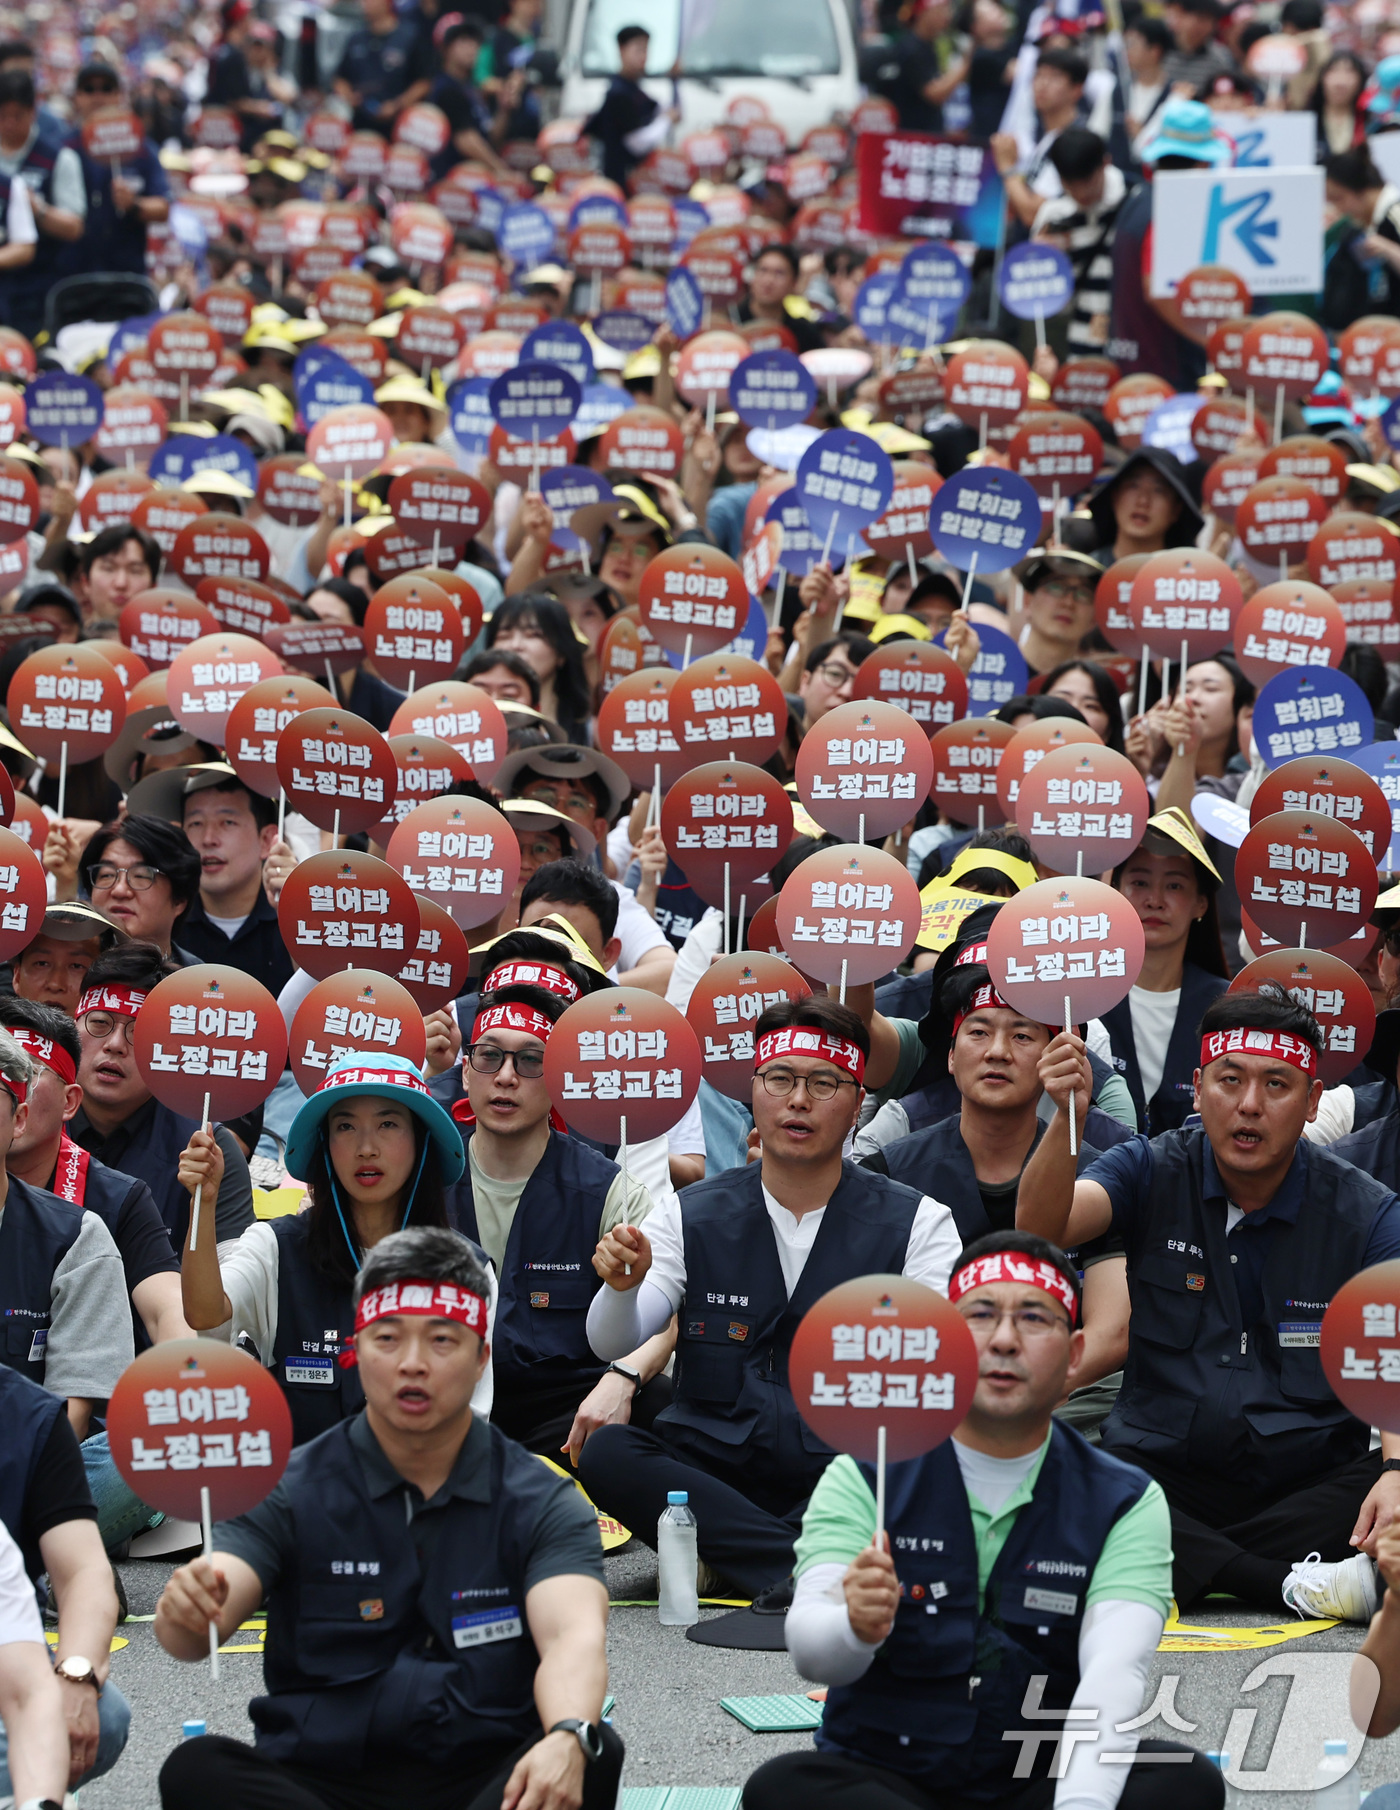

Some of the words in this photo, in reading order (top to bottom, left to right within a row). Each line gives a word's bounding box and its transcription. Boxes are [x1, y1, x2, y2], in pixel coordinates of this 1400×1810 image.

[1259, 334, 1314, 357] 열어라
[746, 370, 800, 390] 멈춰라
[962, 361, 1016, 386] 열어라
[1246, 357, 1320, 382] 노정교섭
[507, 379, 564, 398] 멈춰라
[737, 391, 807, 411] 일방통행
[952, 385, 1022, 410] 노정교섭
[499, 397, 573, 418] 일방통행
[325, 421, 378, 444] 열어라
[618, 426, 669, 449] 열어라
[1028, 434, 1084, 456] 열어라
[316, 440, 385, 464] 노정교섭
[608, 449, 675, 471] 노정교섭
[819, 450, 879, 483] 멈춰라
[1018, 453, 1094, 477] 노정교섭
[412, 481, 471, 503] 열어라
[804, 473, 882, 512] 일방통행
[957, 489, 1023, 521] 멈춰라
[399, 501, 480, 525] 노정교섭
[1254, 499, 1310, 522] 열어라
[938, 510, 1026, 550] 일방통행
[1246, 521, 1319, 546] 노정교섭
[193, 534, 251, 556] 열어라
[1325, 537, 1384, 562] 열어라
[184, 555, 260, 578] 노정교섭
[1319, 562, 1397, 588] 노정교섭
[664, 571, 729, 600] 열어라
[1153, 577, 1221, 604] 열어라
[385, 605, 445, 632] 열어라
[649, 597, 737, 629] 노정교섭
[1141, 606, 1231, 632] 노정교섭
[1261, 607, 1327, 640] 열어라
[374, 634, 453, 664] 노정교섭
[1243, 635, 1332, 667] 노정교섭
[34, 674, 104, 703] 열어라
[191, 662, 261, 686] 열어라
[878, 666, 946, 696] 열어라
[691, 684, 761, 713] 열어라
[1274, 693, 1345, 726] 멈춰라
[20, 704, 112, 734] 노정교섭
[411, 710, 481, 740] 열어라
[683, 713, 775, 743] 노정교섭
[302, 738, 373, 770] 열어라
[458, 737, 495, 764] 교섭
[826, 738, 906, 766] 열어라
[1267, 721, 1362, 758] 일방통행
[291, 767, 385, 803] 노정교섭
[810, 772, 918, 800] 노정교섭
[1046, 779, 1123, 807] 열어라
[689, 794, 767, 819] 열어라
[677, 824, 778, 849] 노정교섭
[1030, 811, 1134, 840] 노정교섭
[417, 830, 495, 861] 열어라
[1267, 842, 1350, 878] 열어라
[402, 864, 504, 895] 노정교섭
[308, 884, 391, 915] 열어라
[810, 881, 894, 911] 열어라
[1250, 875, 1362, 914] 노정교섭
[295, 920, 405, 951] 노정교섭
[653, 909, 695, 938] 단결
[791, 916, 904, 947] 노정교섭
[1019, 913, 1111, 946] 열어라
[398, 959, 452, 988] 교섭
[1005, 947, 1127, 984] 노정교섭
[482, 965, 513, 993] 단결
[541, 969, 579, 1000] 투쟁
[77, 988, 103, 1017] 단결
[122, 991, 145, 1017] 투
[712, 989, 789, 1025] 열어라
[168, 1004, 258, 1041] 열어라
[323, 1004, 402, 1047] 열어라
[479, 1006, 505, 1033] 단결
[14, 1032, 53, 1061] 투쟁
[302, 1039, 355, 1070] 노정
[577, 1030, 668, 1061] 열어라
[758, 1027, 792, 1061] 단결
[821, 1034, 860, 1072] 투쟁
[1209, 1030, 1245, 1059] 단결
[1273, 1033, 1312, 1070] 투쟁
[150, 1043, 269, 1081] 노정교섭
[562, 1068, 683, 1100] 노정교섭
[1167, 1239, 1186, 1253] 단결
[957, 1256, 1002, 1290] 단결
[1034, 1263, 1075, 1310] 투쟁
[360, 1283, 399, 1320] 단결
[434, 1291, 480, 1325] 투쟁
[706, 1292, 726, 1305] 단결
[728, 1295, 749, 1307] 투쟁
[302, 1341, 320, 1353] 단결
[831, 1325, 940, 1365] 열어라
[307, 1370, 328, 1380] 정은주
[142, 1385, 251, 1426] 열어라
[809, 1371, 955, 1412] 노정교섭
[130, 1429, 273, 1472] 노정교섭
[896, 1536, 918, 1551] 단결
[921, 1537, 944, 1552] 투쟁
[331, 1560, 354, 1575] 단결
[357, 1561, 380, 1576] 투쟁
